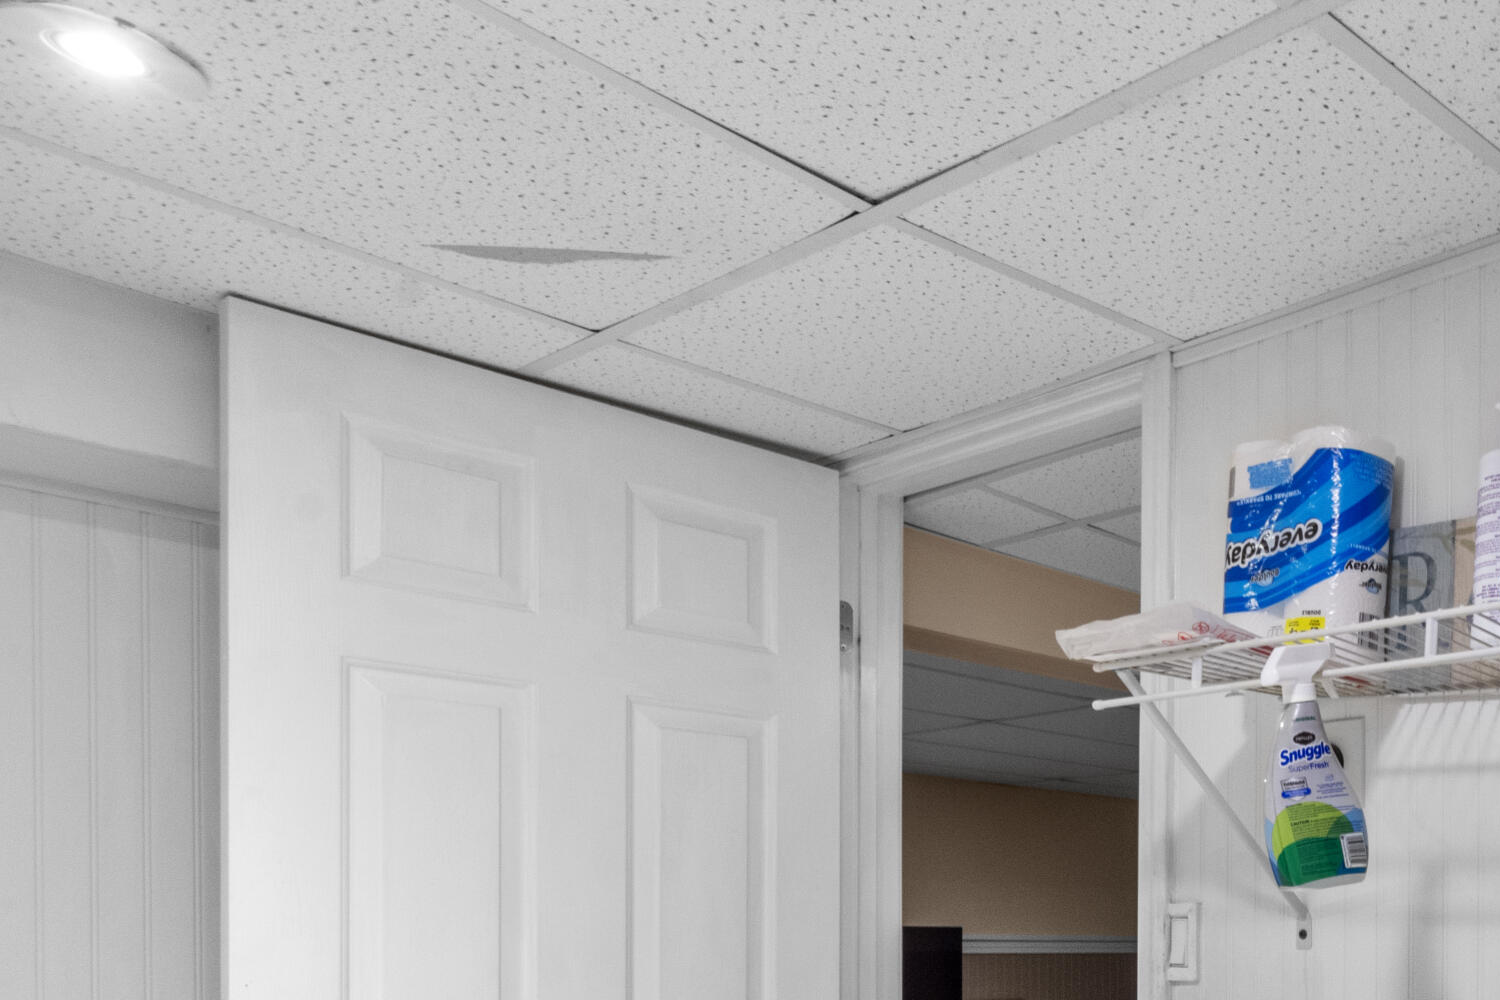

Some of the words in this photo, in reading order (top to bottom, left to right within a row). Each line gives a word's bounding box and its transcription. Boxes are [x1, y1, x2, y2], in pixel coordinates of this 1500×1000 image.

[1225, 520, 1321, 568] everyday
[1346, 559, 1388, 577] veryday
[1280, 741, 1331, 766] Snuggle
